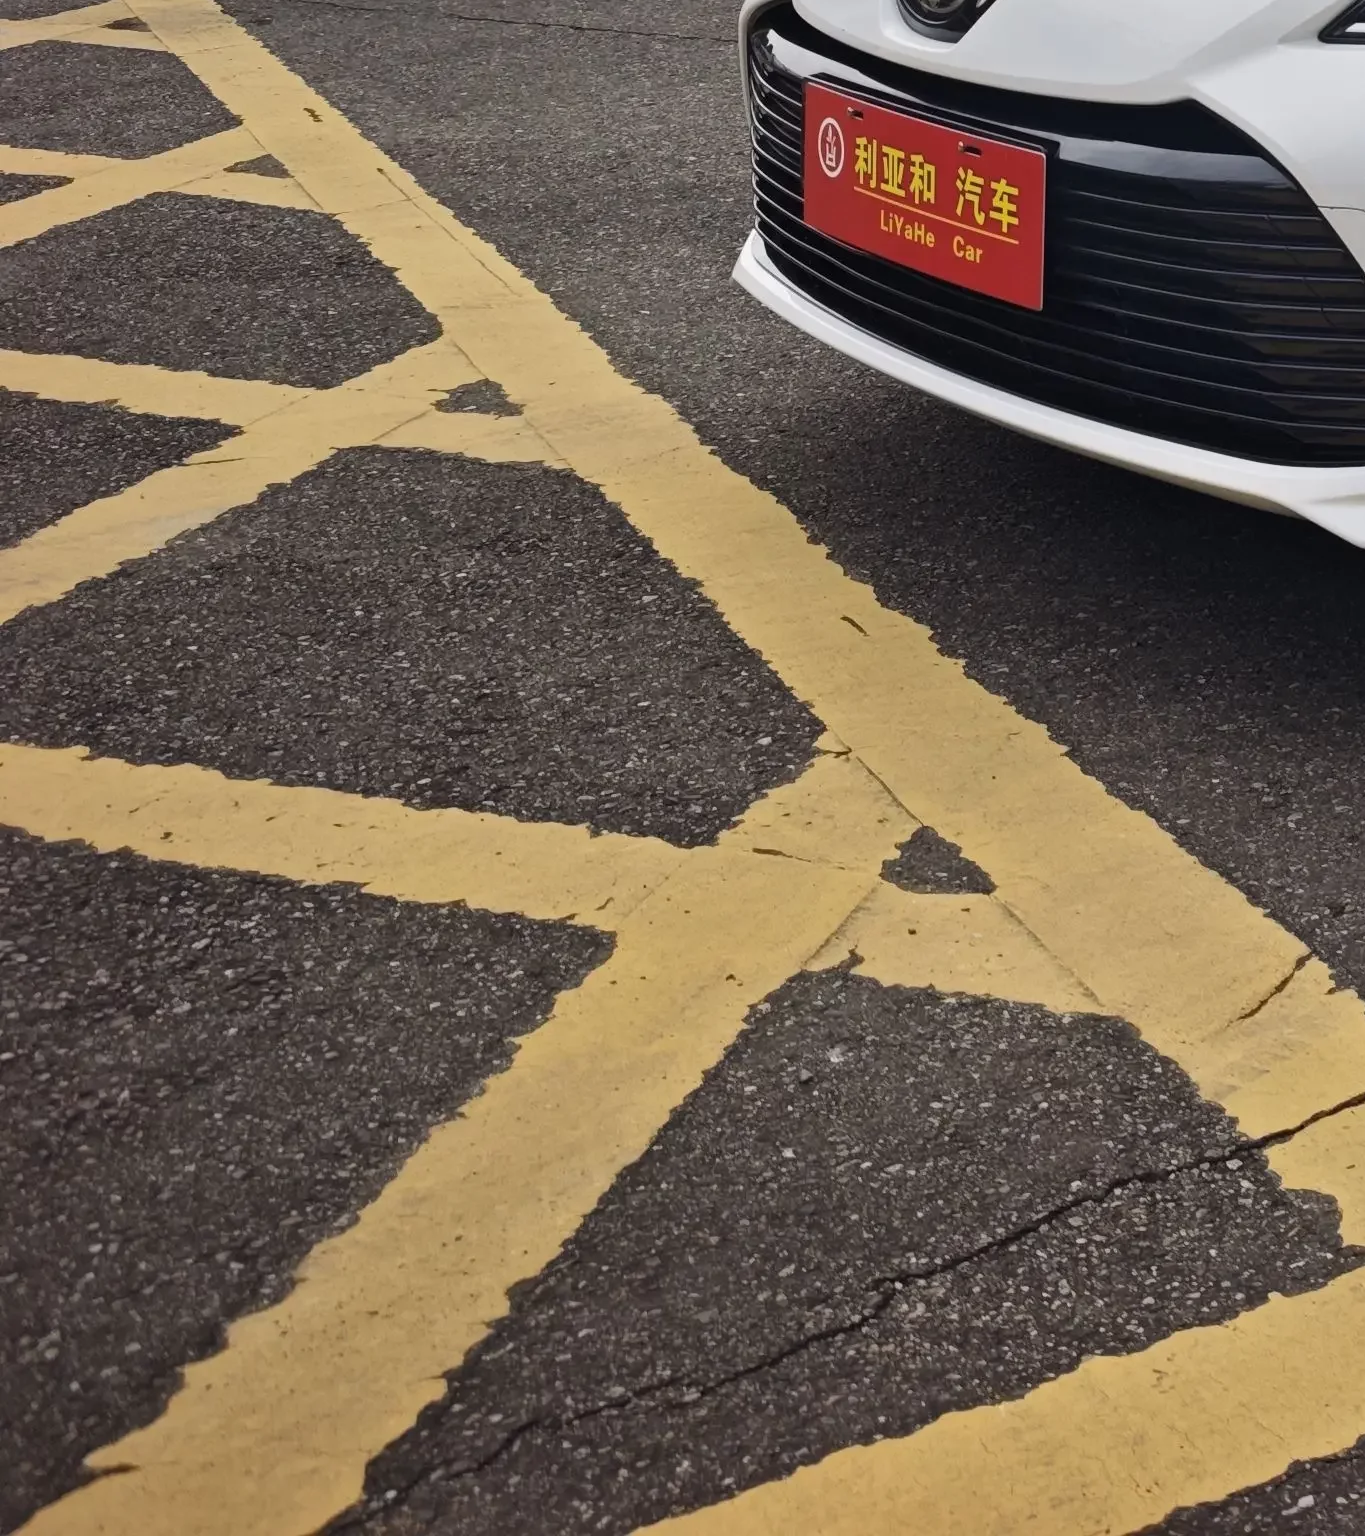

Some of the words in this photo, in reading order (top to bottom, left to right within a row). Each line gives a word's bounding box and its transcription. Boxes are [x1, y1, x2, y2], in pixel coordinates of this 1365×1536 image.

[854, 136, 936, 205] 利亚和
[955, 166, 1020, 234] 汽车
[880, 209, 936, 248] LiYaHe
[953, 235, 984, 264] Car
